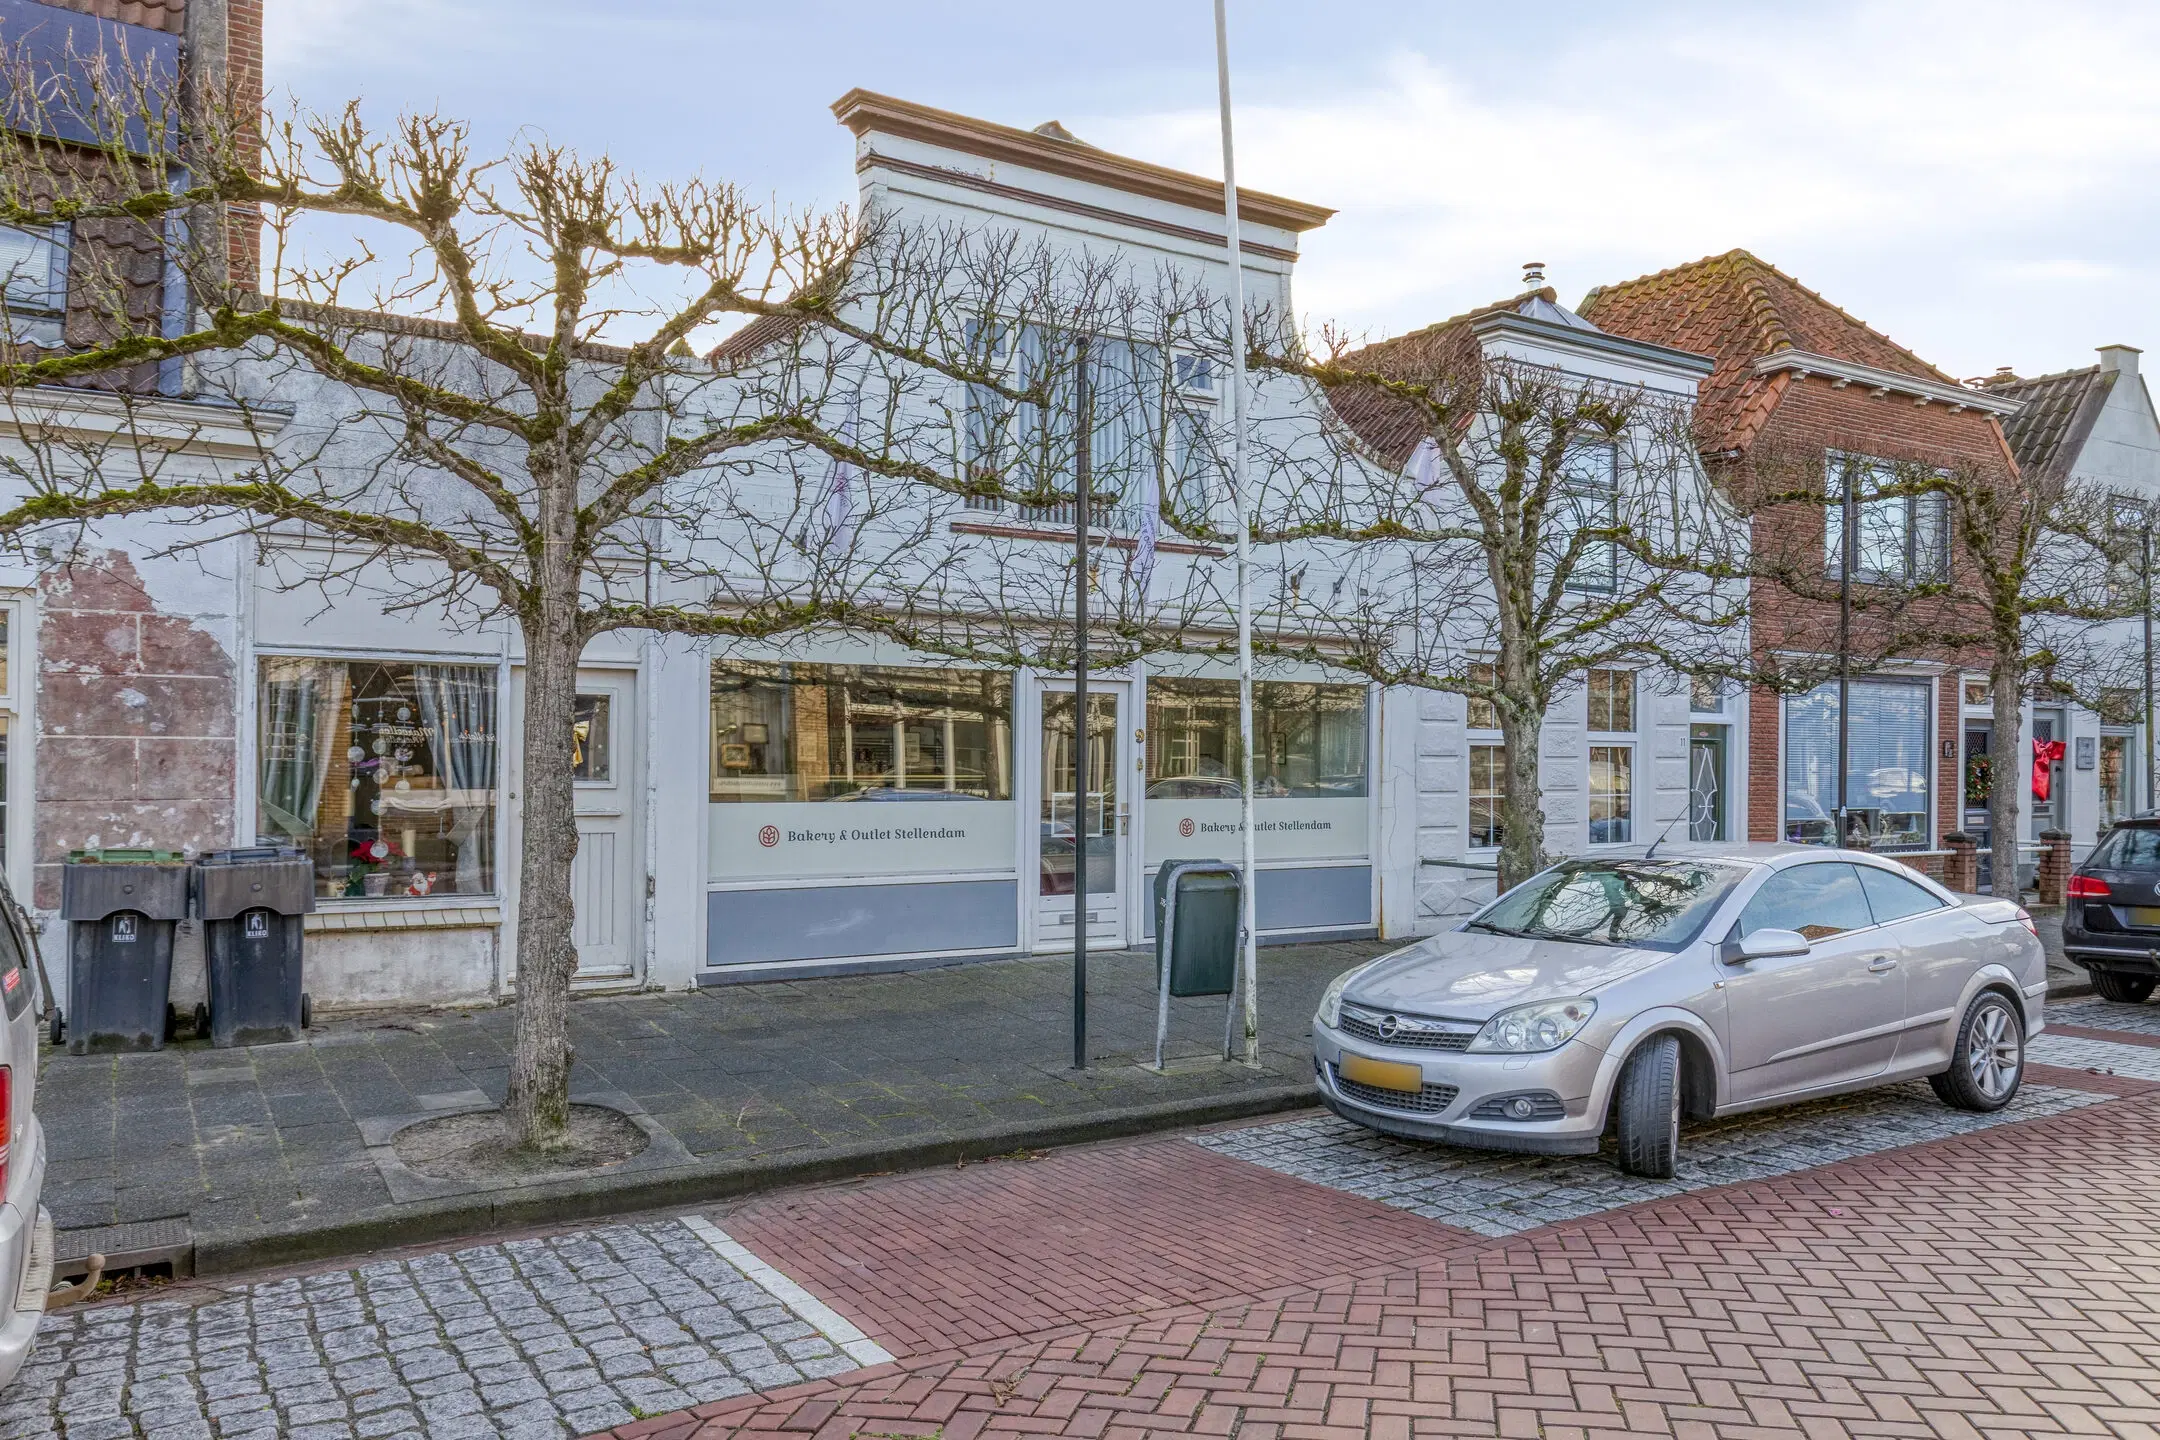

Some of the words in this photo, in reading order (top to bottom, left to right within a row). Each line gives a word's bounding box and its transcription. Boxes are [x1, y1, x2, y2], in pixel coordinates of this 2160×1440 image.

[1135, 729, 1145, 743] 9
[1201, 822, 1235, 834] Bakery
[1254, 820, 1277, 831] utlet
[1278, 820, 1332, 831] Stellendam
[787, 829, 836, 844] Bakery
[839, 829, 847, 841] &
[851, 829, 891, 840] Outlet
[894, 827, 966, 840] Stellendam
